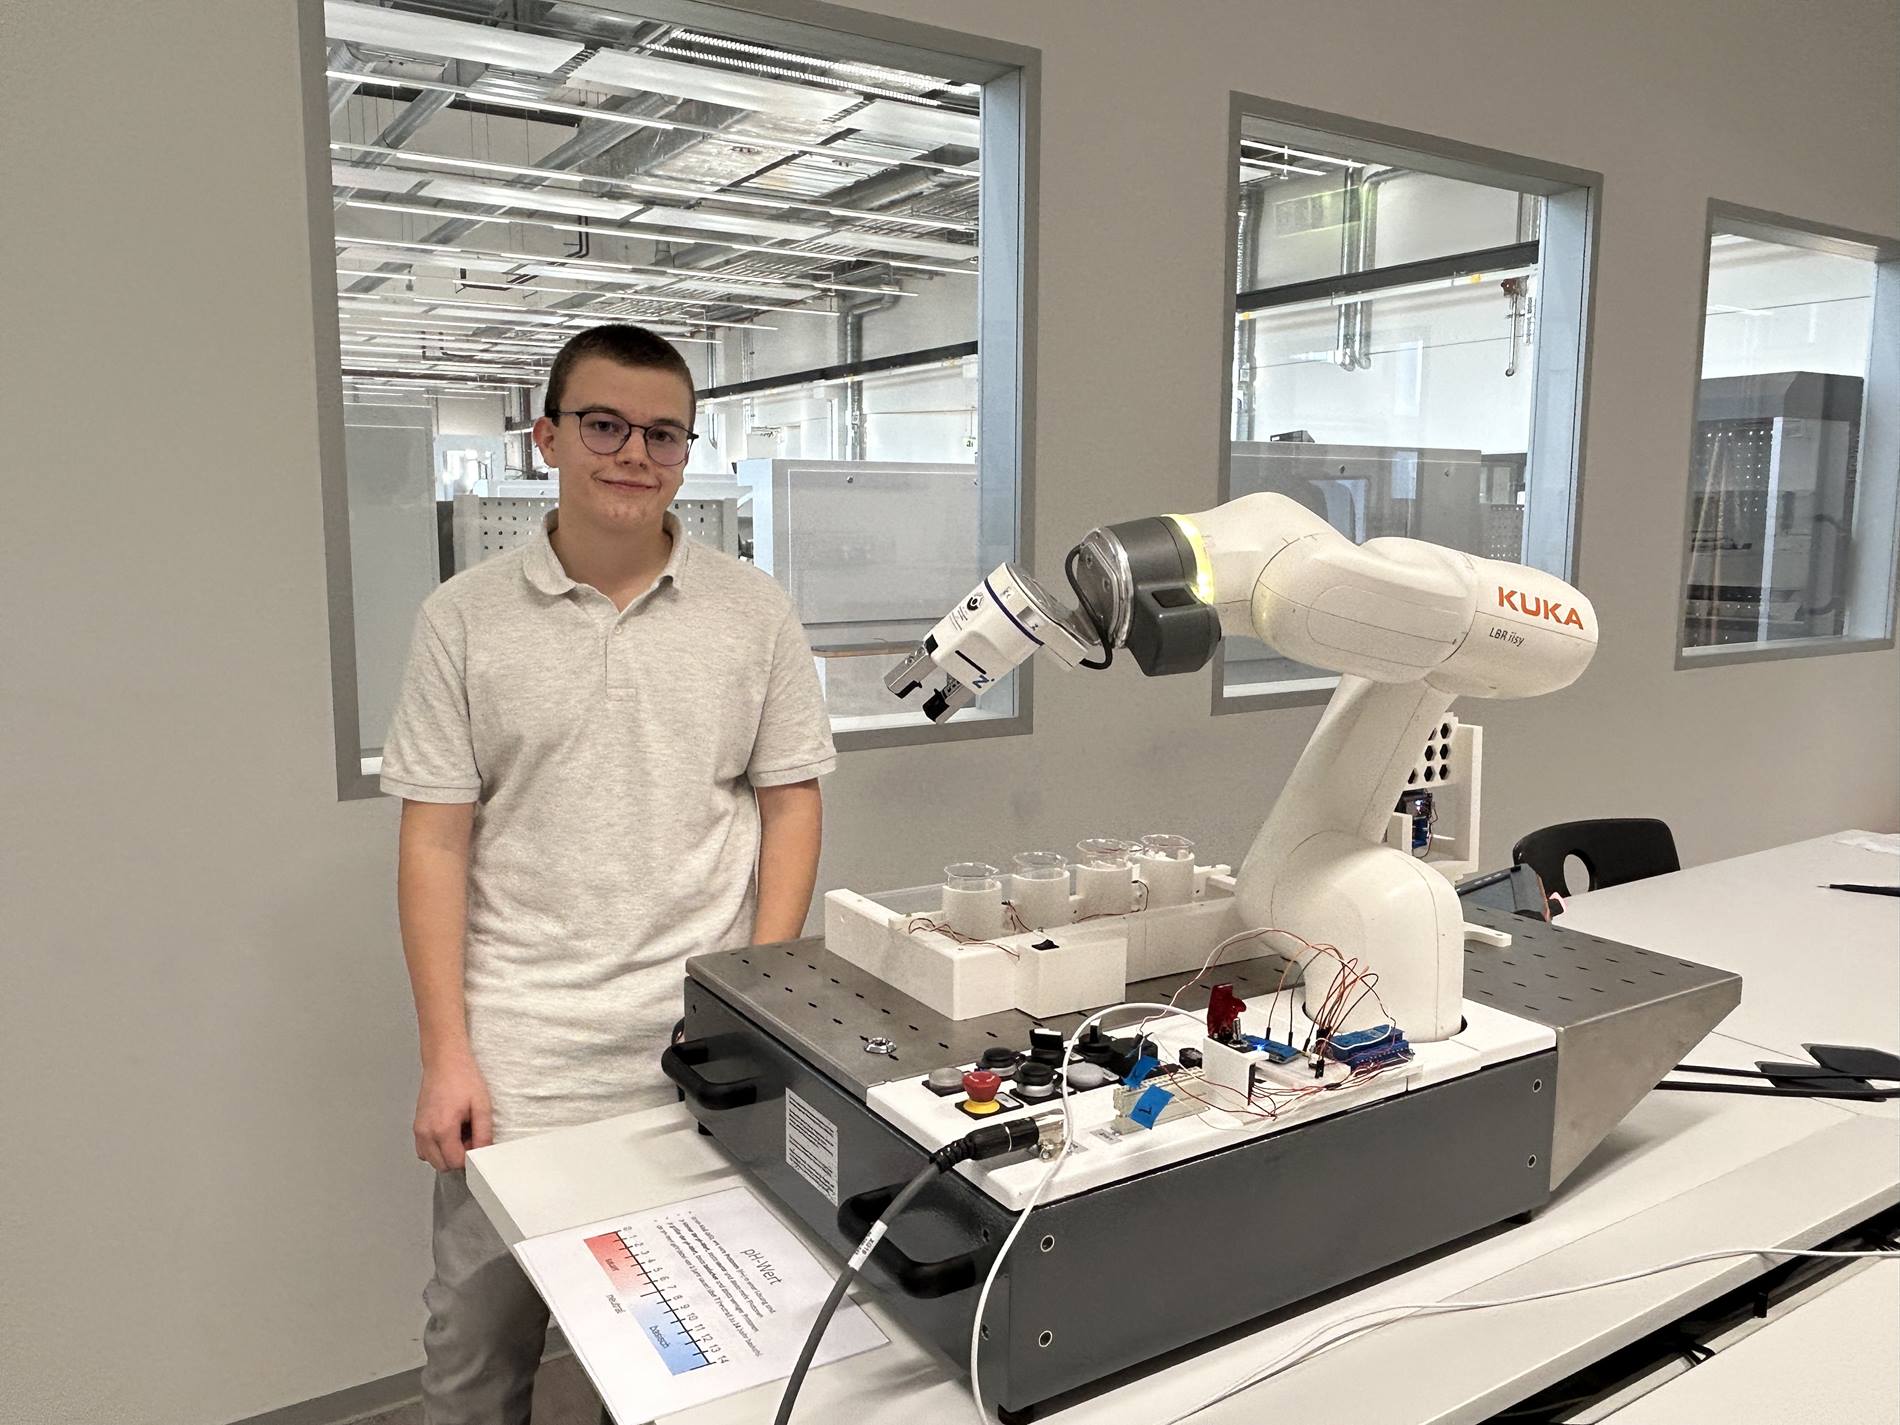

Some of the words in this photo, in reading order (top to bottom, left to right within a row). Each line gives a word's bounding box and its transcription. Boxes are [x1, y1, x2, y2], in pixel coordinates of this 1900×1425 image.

[1498, 586, 1584, 631] KUKA
[1488, 627, 1507, 641] LBR
[740, 1249, 783, 1285] pH-Wert
[606, 1294, 626, 1314] neutral
[649, 1324, 671, 1349] basisch
[687, 1312, 698, 1321] 10
[694, 1323, 706, 1331] 11
[702, 1333, 714, 1343] 12
[709, 1344, 721, 1353] 13
[717, 1354, 730, 1364] 14
